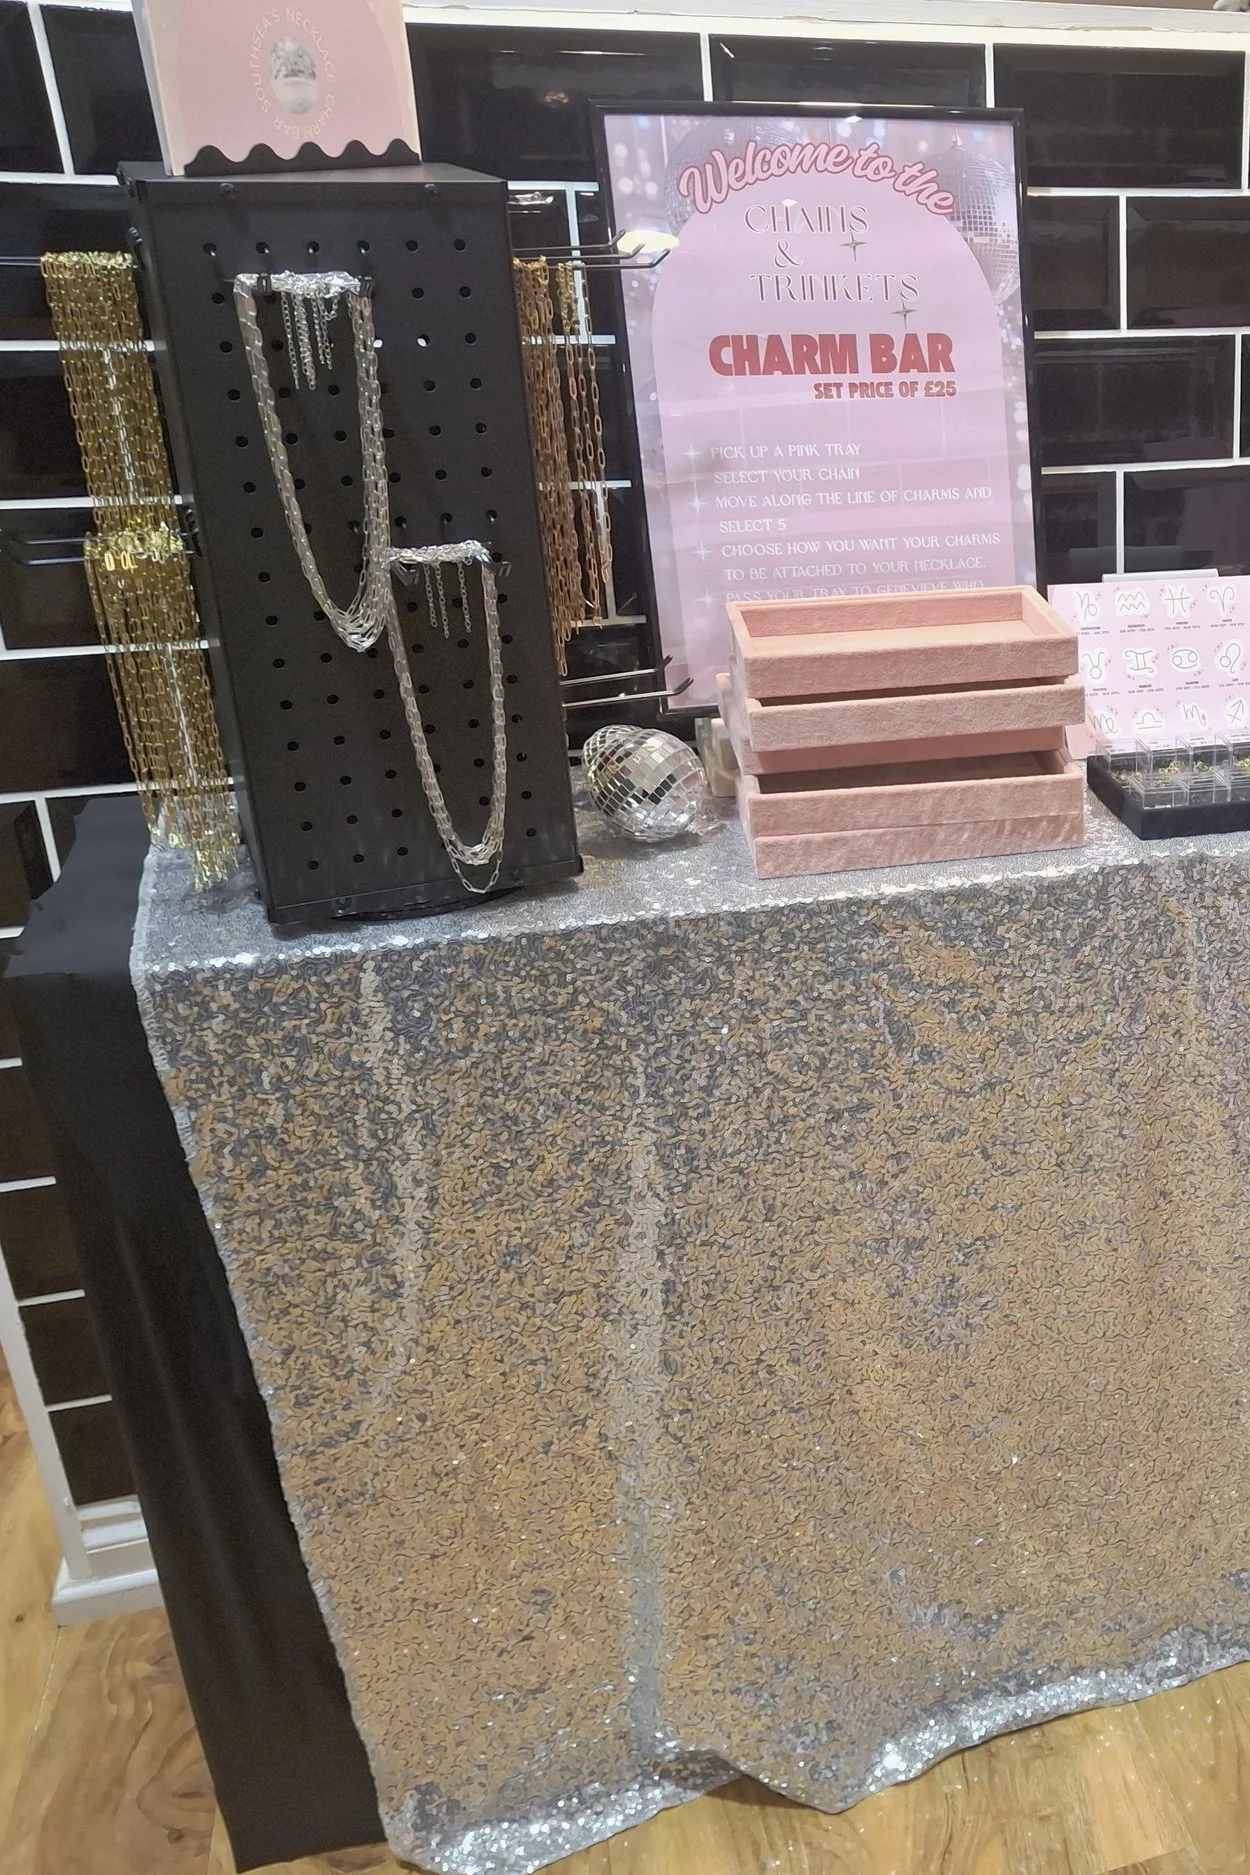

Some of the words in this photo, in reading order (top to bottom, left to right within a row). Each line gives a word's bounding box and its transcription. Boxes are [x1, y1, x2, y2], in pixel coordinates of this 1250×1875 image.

[286, 7, 336, 83] NECKLACE
[249, 8, 281, 113] SOUTHSEA'S
[274, 114, 300, 140] BAR
[302, 94, 335, 139] CHARM
[679, 140, 856, 215] Welcome
[851, 142, 898, 182] to
[893, 160, 955, 215] the
[743, 205, 870, 233] CHAINS
[773, 239, 802, 268] &
[750, 273, 920, 302] TRINKETS
[708, 334, 859, 376] CHARM
[869, 333, 956, 373] BAR
[813, 382, 843, 400] SET
[848, 381, 894, 399] PRICE
[900, 381, 919, 398] OF
[923, 380, 957, 397] £25
[711, 446, 745, 459] PICK
[750, 446, 769, 458] UP
[773, 445, 784, 457] A
[788, 444, 820, 457] PINK
[825, 442, 861, 456] TRAY
[713, 470, 767, 484] SELECT
[773, 468, 814, 482] YOUR
[818, 466, 860, 481] CHAIN
[716, 495, 758, 509] MOVE
[762, 493, 812, 507] ALONG
[817, 491, 844, 505] THE
[848, 490, 876, 504] LINE
[880, 489, 899, 502] OF
[903, 487, 960, 501] CHARMS
[965, 486, 992, 499] AND
[719, 519, 773, 533] SELECT
[777, 518, 787, 531] 5
[722, 542, 783, 557] CHOOSE
[787, 540, 820, 554] HOW
[825, 539, 855, 553] YOU
[859, 537, 897, 551] WANT
[903, 535, 941, 549] YOUR
[945, 533, 1001, 547] CHARMS
[724, 568, 745, 581] TO
[750, 567, 767, 579] BE
[773, 564, 842, 578] ATTACHED
[848, 563, 867, 575] TO
[872, 560, 910, 574] YOUR
[914, 556, 987, 571] NECKLACE.
[726, 590, 761, 603] PASS
[767, 588, 804, 602] YOUR
[811, 586, 846, 597] TRAY
[853, 585, 872, 595] TO
